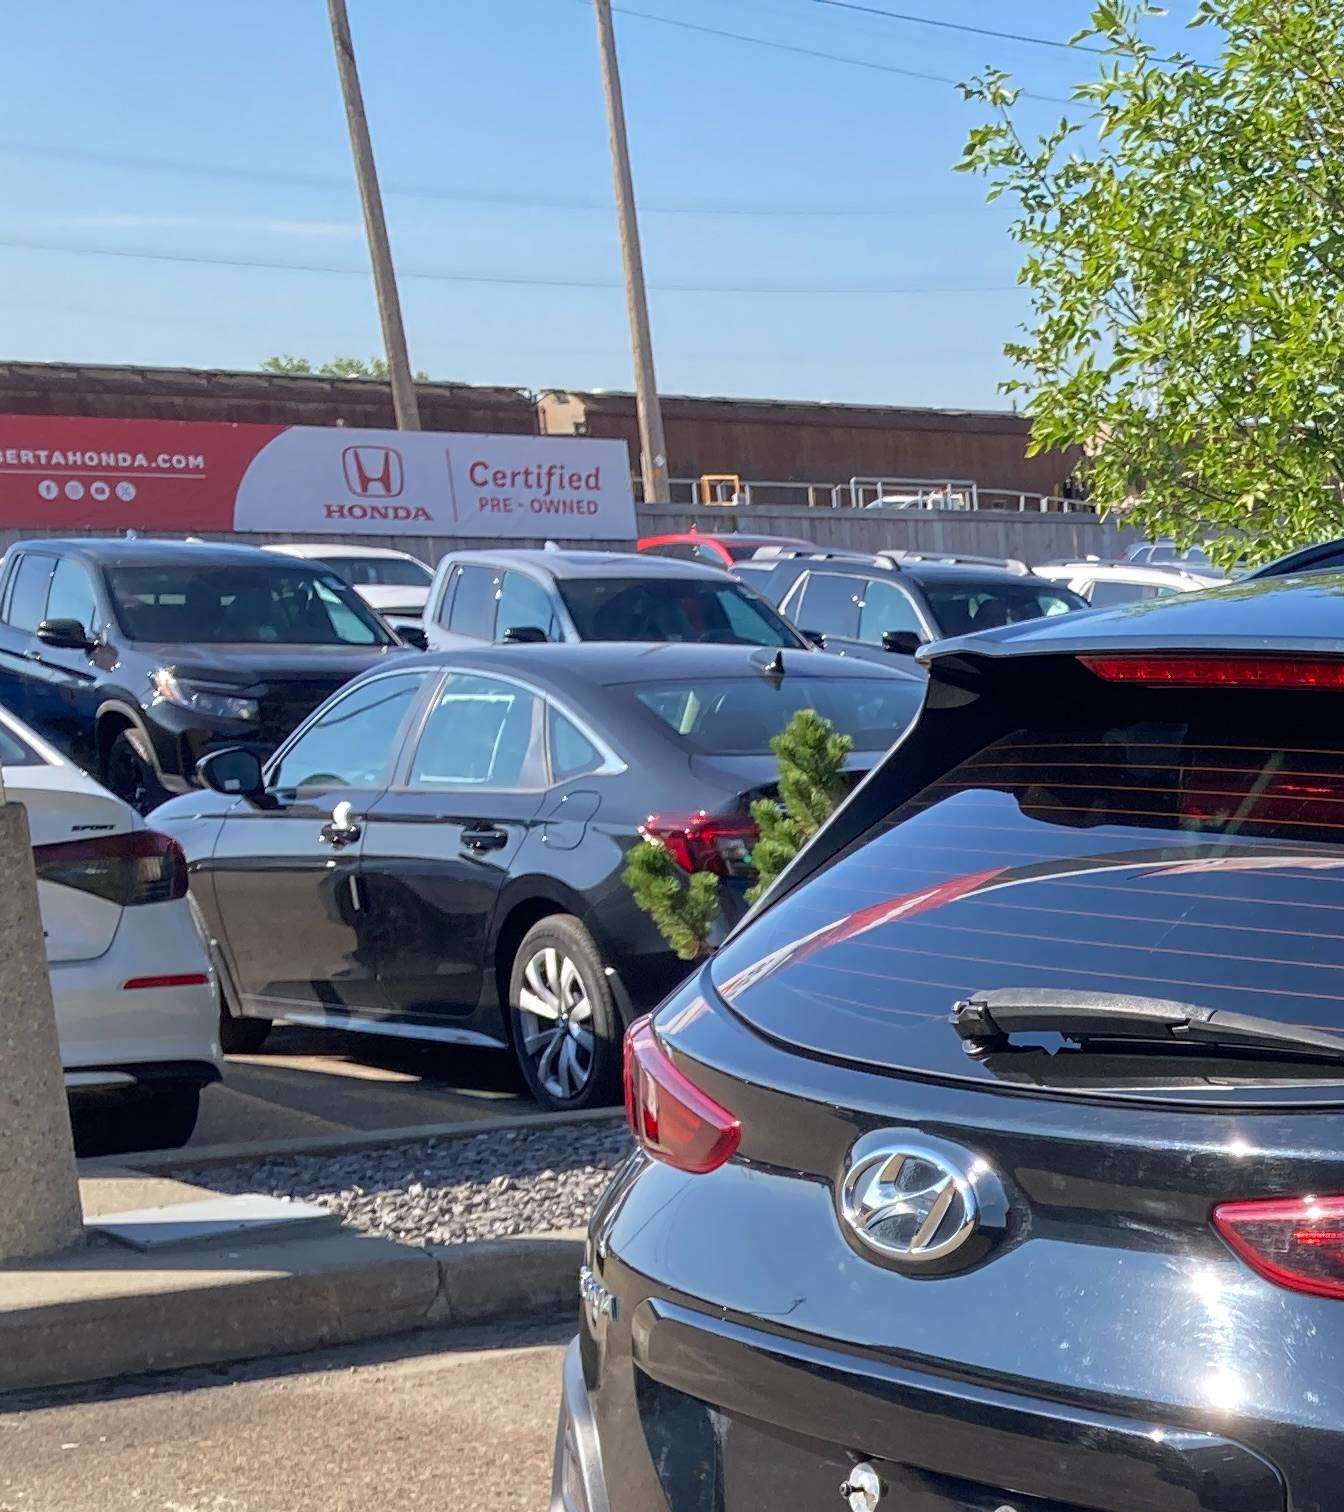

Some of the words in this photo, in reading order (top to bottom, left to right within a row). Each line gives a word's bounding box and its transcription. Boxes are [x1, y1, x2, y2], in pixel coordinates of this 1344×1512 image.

[469, 461, 600, 497] Certified
[323, 503, 434, 521] HONDA
[479, 497, 513, 514] PRE
[530, 499, 600, 516] OWNED
